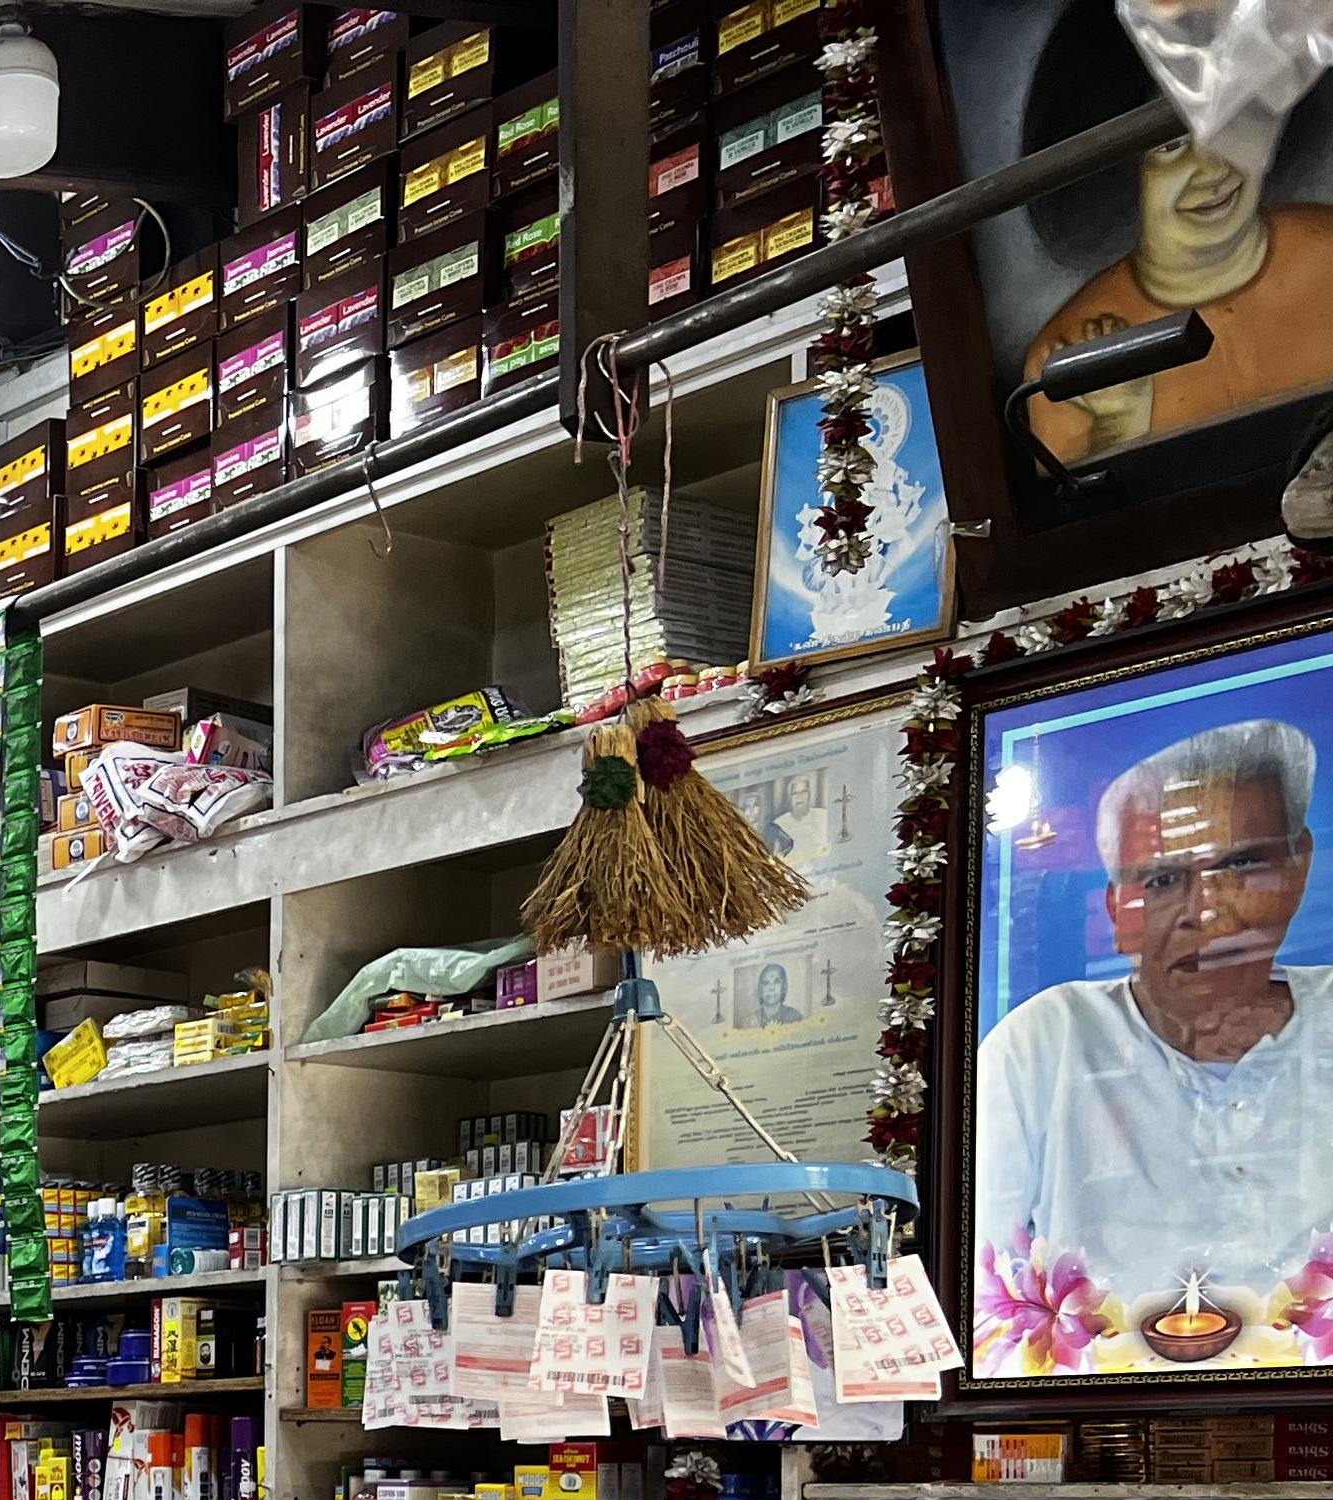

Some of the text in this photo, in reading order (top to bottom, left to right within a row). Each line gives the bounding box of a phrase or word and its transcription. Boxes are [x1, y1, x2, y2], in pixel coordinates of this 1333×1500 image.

[266, 18, 298, 43] Lavender
[227, 43, 258, 66] Lavender
[358, 90, 391, 114] Lavender
[262, 113, 270, 156] Lavender
[315, 115, 348, 138] Lavender
[499, 119, 535, 140] Red Rose
[262, 168, 270, 210] Lavender
[107, 228, 132, 246] Jasmine
[522, 228, 542, 244] Rose
[266, 241, 294, 260] Jasmine
[225, 260, 252, 281] Jasmine
[342, 294, 378, 315] Lavender
[300, 316, 333, 336] Lavender
[257, 340, 281, 357] Jasmine
[254, 435, 279, 450] Jasmine
[152, 487, 177, 504] Jasmine
[91, 776, 119, 829] TRIVEN
[153, 1306, 161, 1359] RUMAGON
[21, 1327, 30, 1390] DENIM
[1288, 1423, 1328, 1434] Shiva
[1288, 1445, 1329, 1457] Shiva
[517, 1474, 548, 1486] WOODS'
[1289, 1467, 1328, 1480] Shiva
